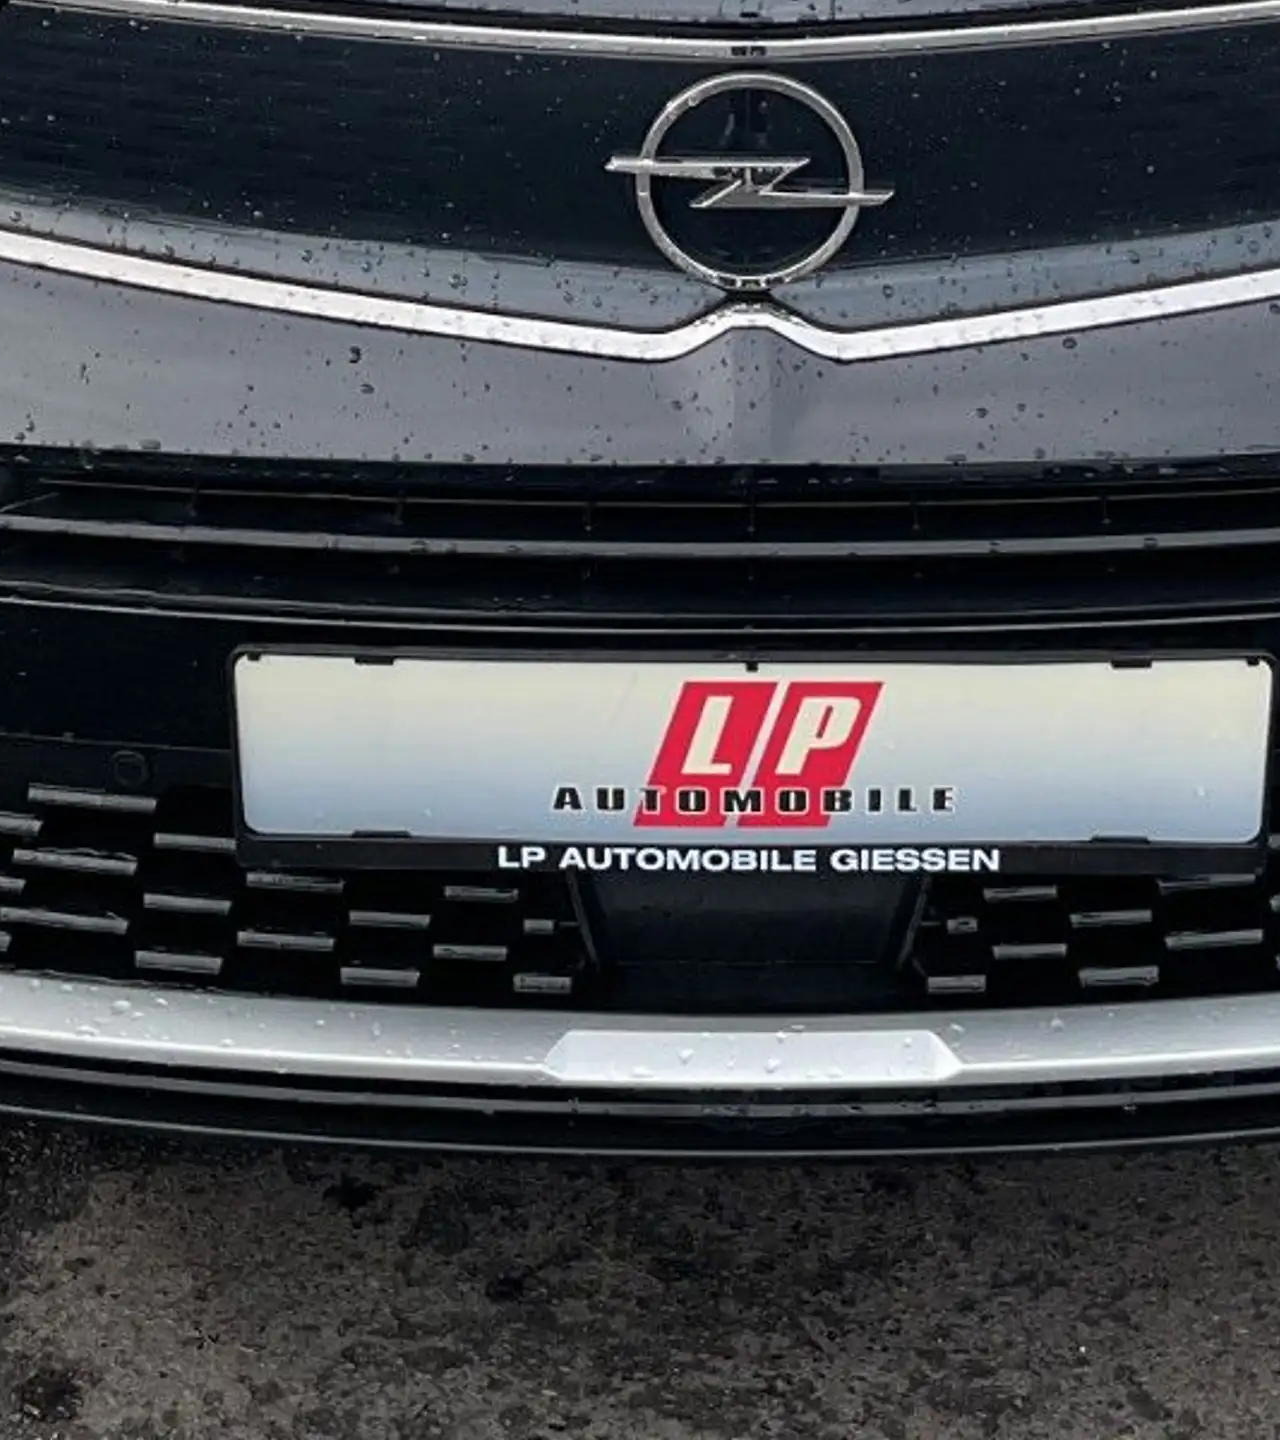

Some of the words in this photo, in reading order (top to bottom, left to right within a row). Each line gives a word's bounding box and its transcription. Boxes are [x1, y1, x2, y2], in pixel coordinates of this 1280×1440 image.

[680, 695, 862, 776] LP
[552, 786, 955, 813] AUTOMOBILE
[497, 845, 547, 869] LP
[558, 846, 818, 872] AUTOMOBILE
[829, 848, 1001, 872] GIESSEN
